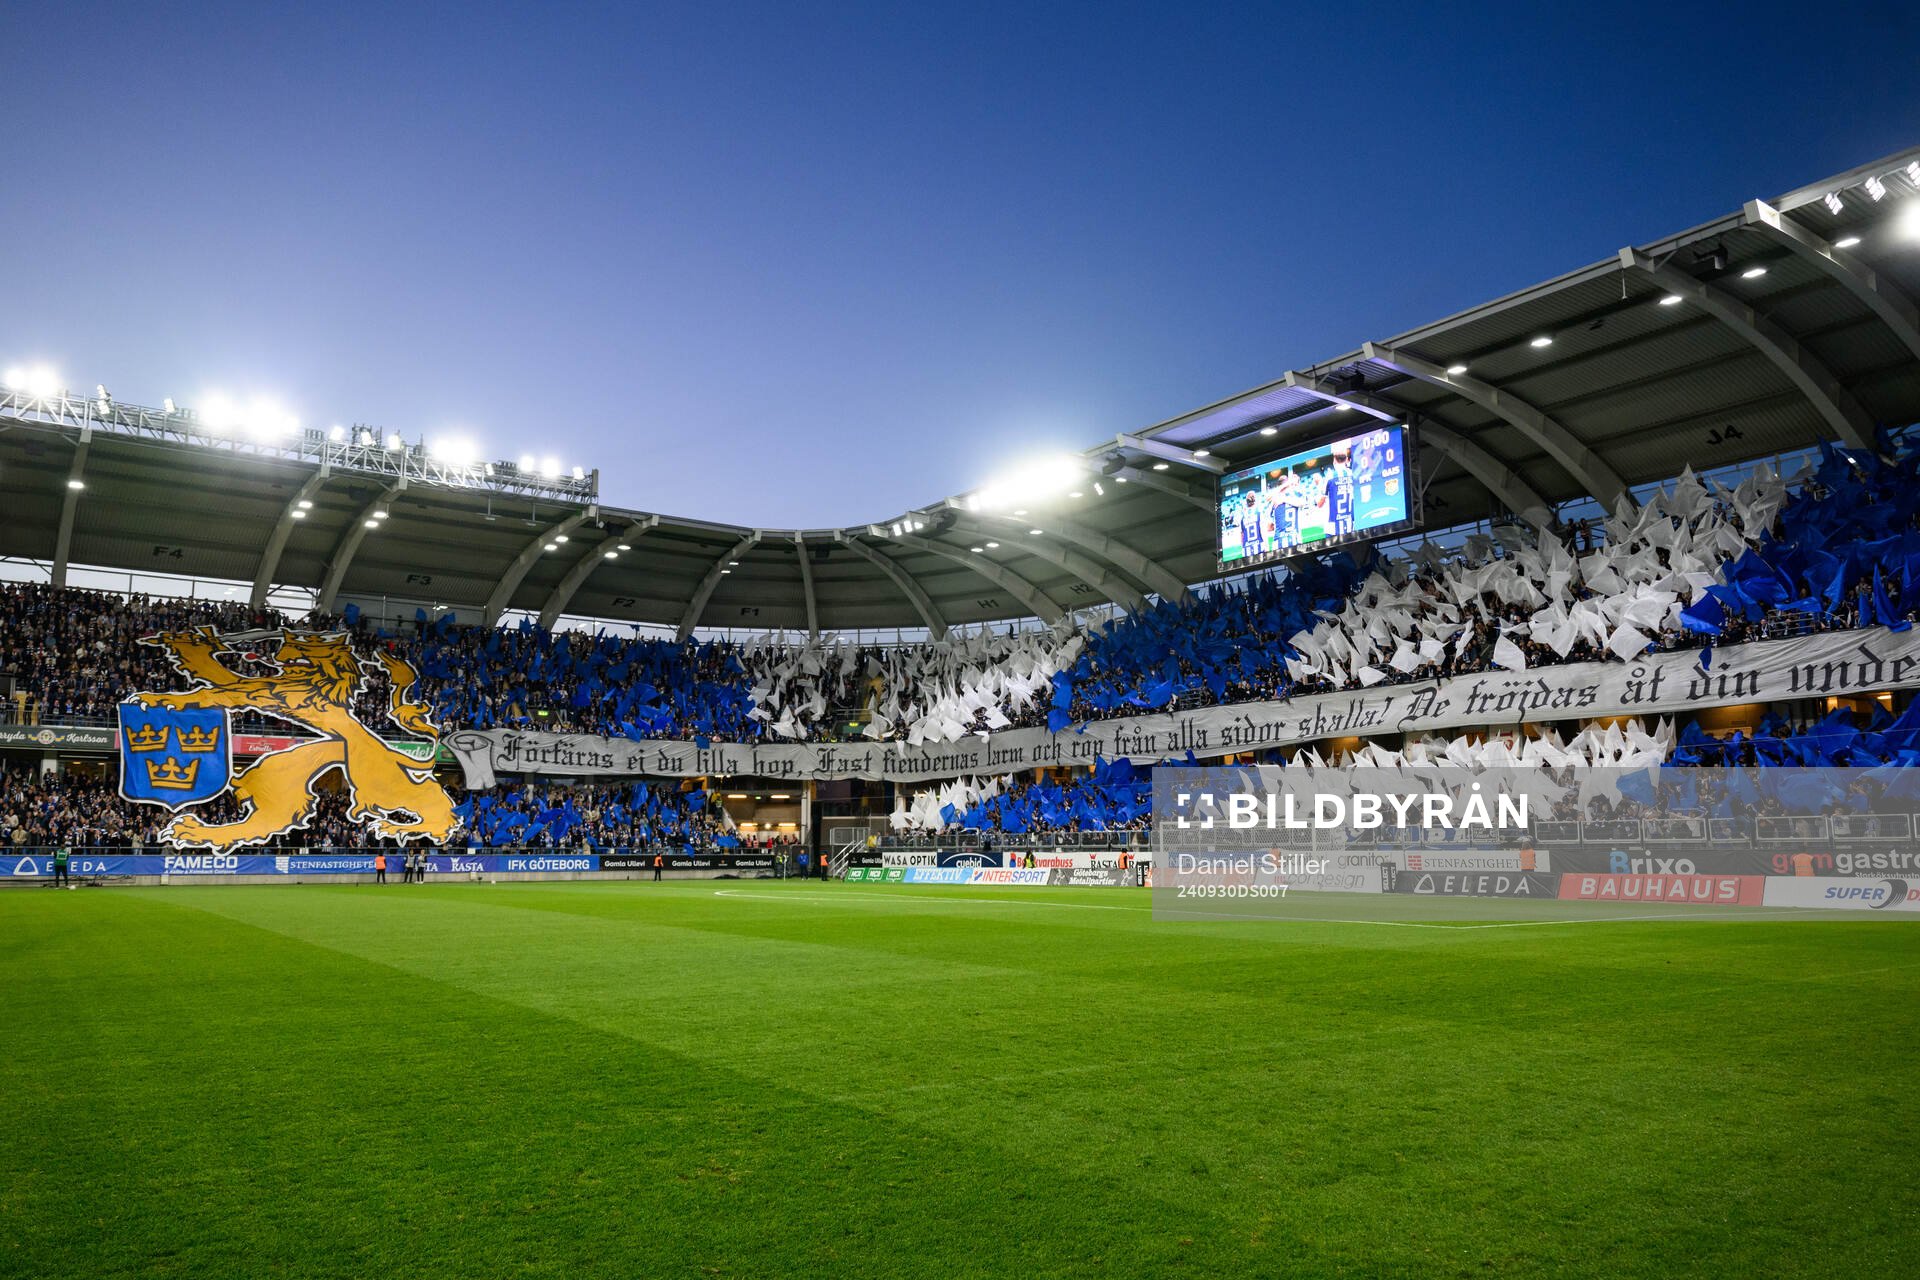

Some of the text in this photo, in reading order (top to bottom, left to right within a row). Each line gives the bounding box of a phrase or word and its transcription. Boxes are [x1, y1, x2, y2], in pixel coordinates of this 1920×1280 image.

[1362, 430, 1390, 450] 0:00
[1705, 423, 1743, 446] J4
[1386, 448, 1394, 462] 0
[152, 545, 184, 559] F4
[406, 574, 432, 585] F3
[1070, 583, 1094, 594] H2
[611, 597, 635, 607] F2
[977, 599, 999, 609] H1
[740, 607, 759, 616] F1
[496, 733, 614, 770] Förfäras
[627, 749, 645, 773] ej
[657, 749, 683, 773] du
[696, 748, 738, 774] lilla
[987, 742, 1024, 766] larm
[1032, 731, 1061, 766] och
[1071, 739, 1103, 762] rop
[1114, 725, 1157, 756] från
[1168, 717, 1208, 750] alla
[1221, 713, 1286, 746] sidor
[1298, 696, 1394, 738] skalla!
[1397, 685, 1450, 732] De
[1619, 664, 1666, 705] åt
[1686, 662, 1762, 701] din
[1786, 642, 1920, 693] unde
[66, 734, 108, 743] Karlsson
[164, 856, 238, 869] FAMECO
[290, 860, 377, 869] STENFASTIGHETE
[508, 857, 590, 870] IFK GÖTEBORG
[884, 855, 936, 866] WASA OPTIK
[955, 857, 982, 868] cuebid
[1424, 858, 1538, 869] STENFASTIGHET
[46, 861, 106, 872] EEDA
[451, 862, 484, 872] RASTA
[982, 871, 1045, 883] INTERSPORT
[1073, 868, 1109, 877] Göteborgs
[1068, 877, 1116, 886] Metallpartier
[1444, 875, 1531, 895] ELEDA
[1580, 877, 1736, 899] BAUHAUS
[1825, 887, 1885, 900] SUPER
